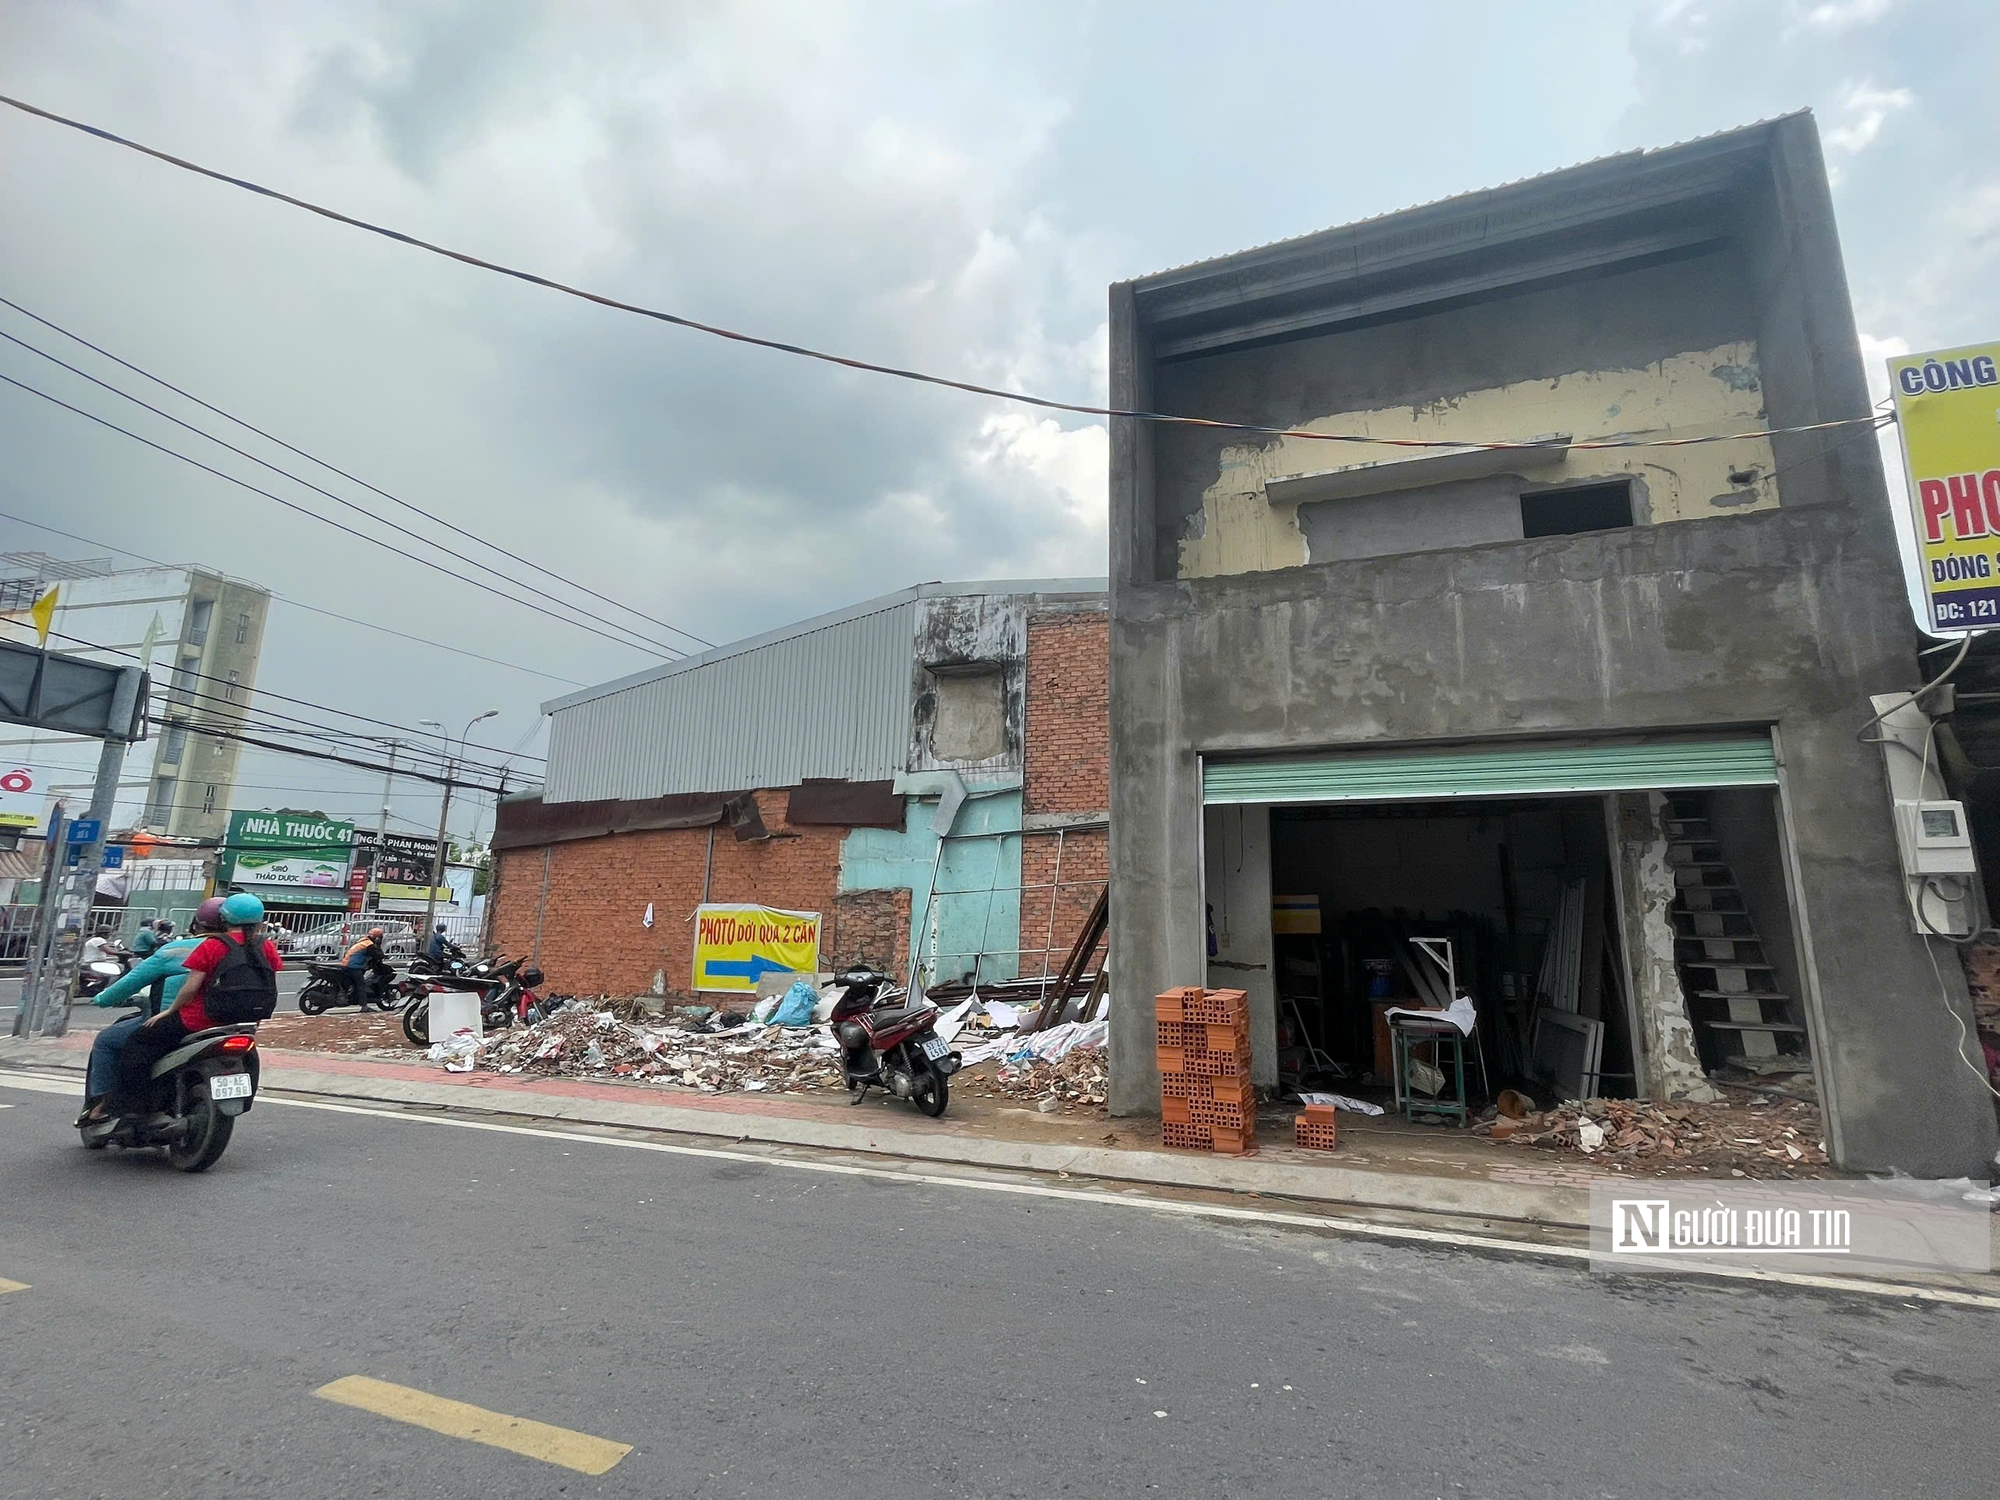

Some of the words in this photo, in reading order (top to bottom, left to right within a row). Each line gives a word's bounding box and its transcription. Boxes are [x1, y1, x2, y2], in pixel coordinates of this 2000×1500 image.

[1899, 355, 1998, 395] CÔNG
[1931, 552, 1991, 583] ĐÓNG
[1936, 604, 1965, 621] ĐC:
[1968, 599, 1997, 617] 121
[246, 817, 280, 836] NHÀ
[285, 820, 335, 841] THUỐC
[337, 828, 353, 843] 41
[699, 918, 736, 945] PHOTO
[760, 924, 780, 946] QUA
[783, 925, 791, 943] 2
[793, 921, 816, 944] CĂN
